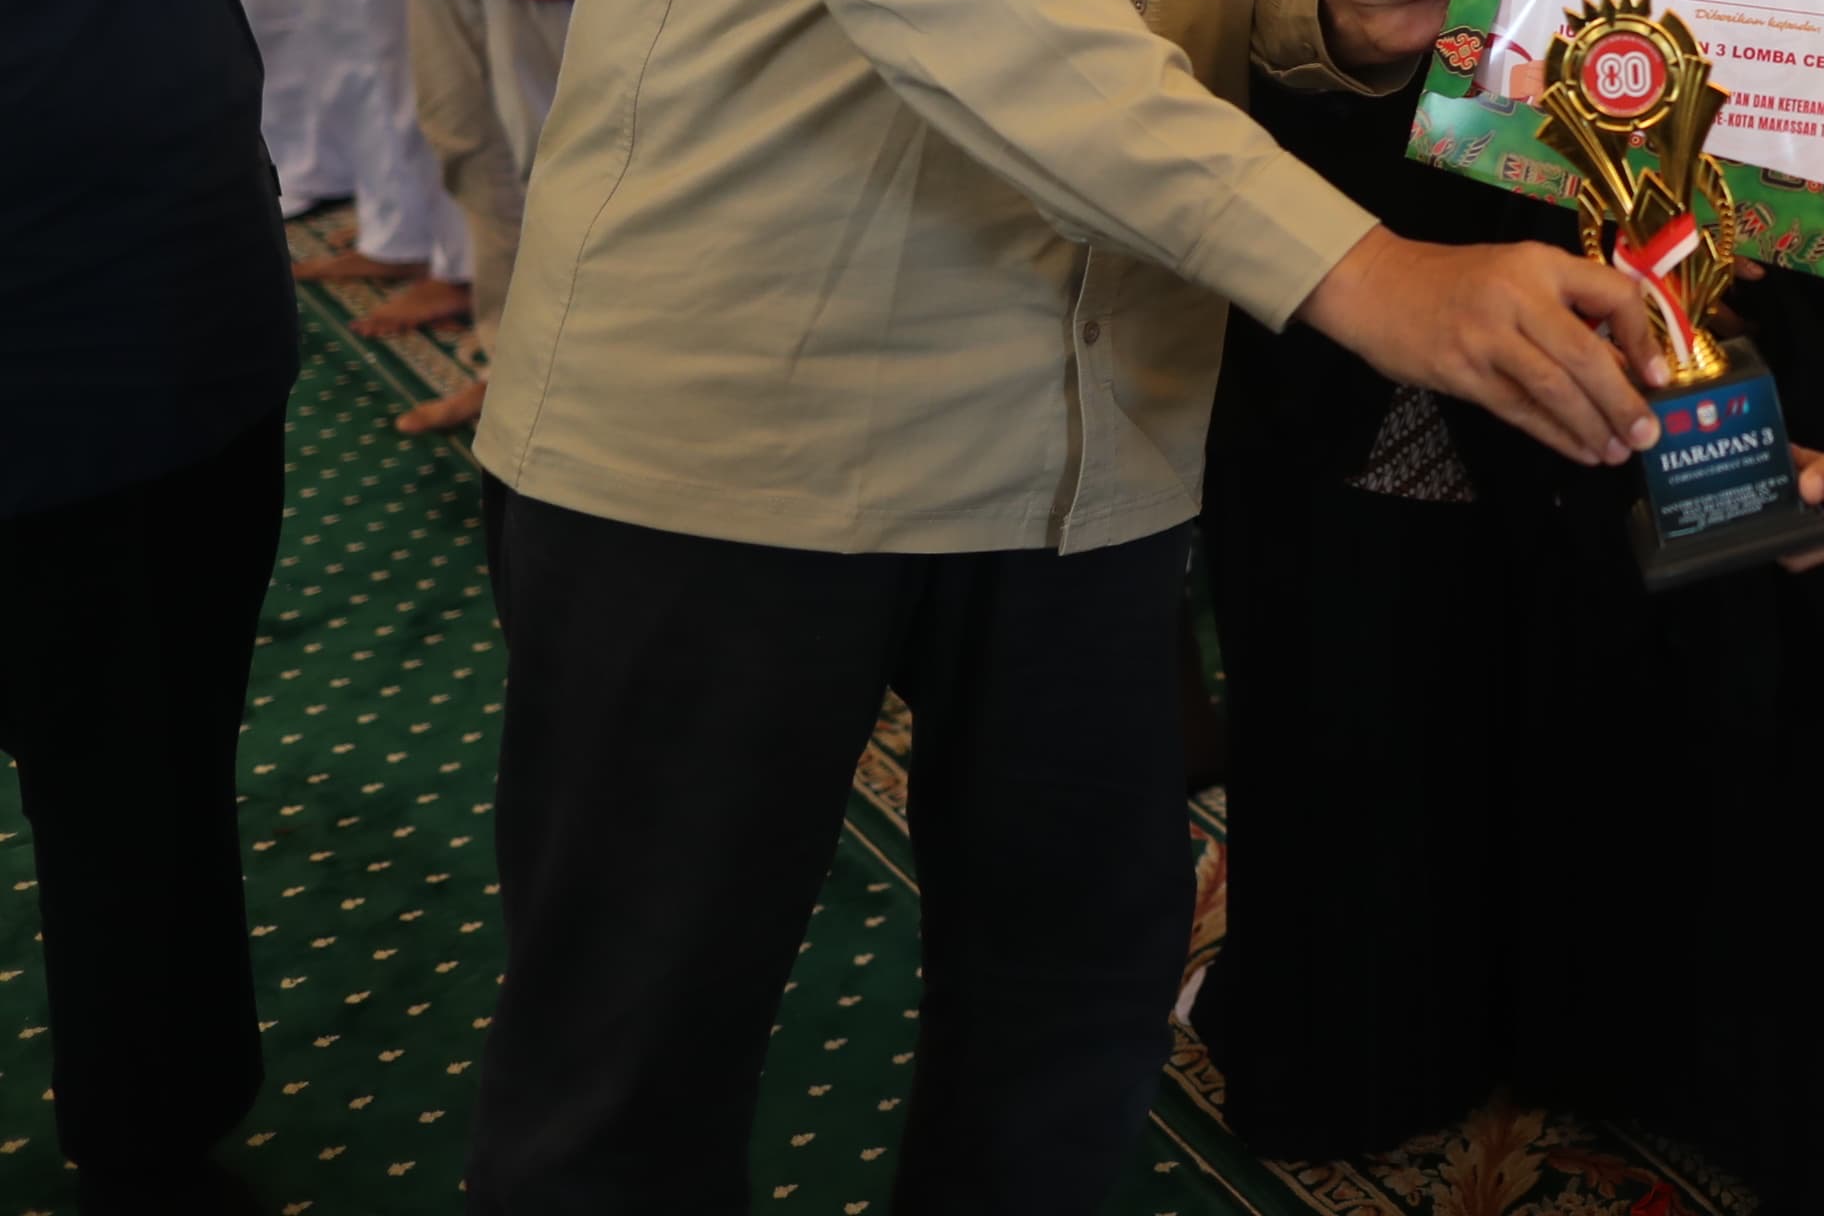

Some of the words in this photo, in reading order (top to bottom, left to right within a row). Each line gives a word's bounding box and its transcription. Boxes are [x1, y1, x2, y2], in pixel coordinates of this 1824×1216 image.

[1695, 7, 1764, 26] Diberikan
[1715, 42, 1726, 57] 3
[1732, 44, 1797, 66] LOMBA
[1596, 51, 1653, 99] 80
[1753, 93, 1775, 110] DAN
[1758, 116, 1817, 137] MAKASSAR
[1661, 429, 1759, 472] HARAPAN
